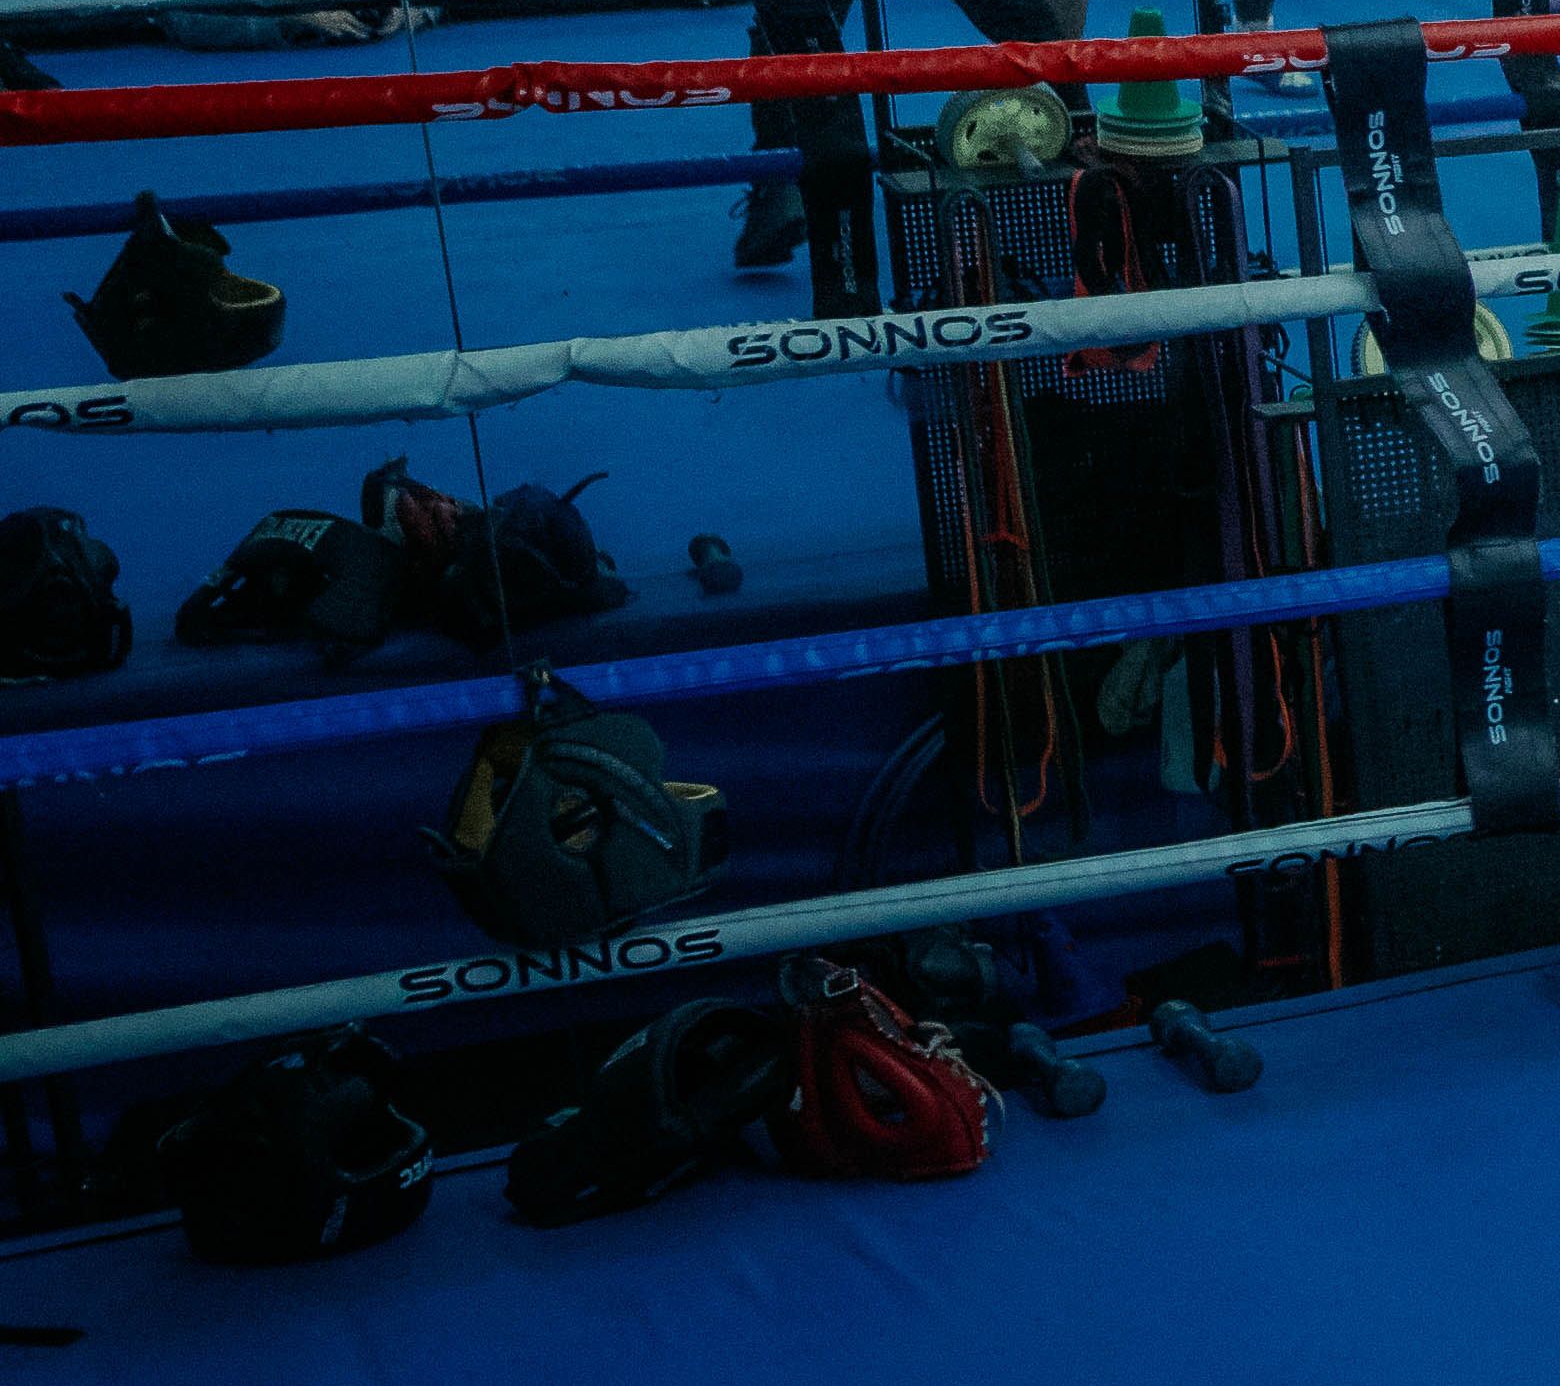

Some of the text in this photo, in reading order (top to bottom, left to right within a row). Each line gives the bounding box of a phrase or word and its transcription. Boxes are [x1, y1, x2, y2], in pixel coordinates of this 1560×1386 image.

[1367, 111, 1404, 236] SONNOS
[728, 309, 1034, 368] SONNOS
[1428, 371, 1500, 485] SONNOS
[1483, 629, 1508, 745] SONNOS
[399, 929, 724, 1004] SONNOS
